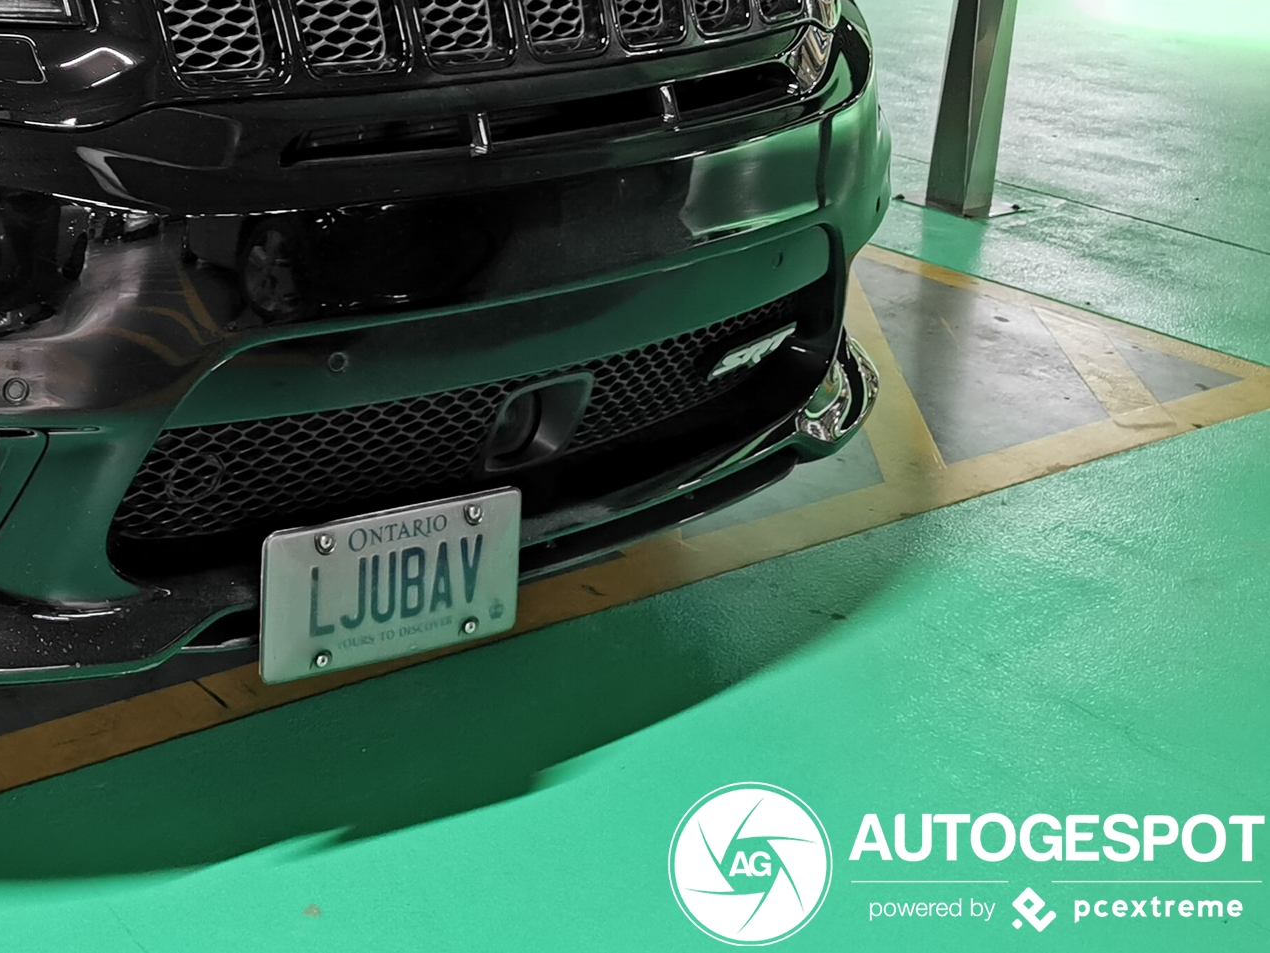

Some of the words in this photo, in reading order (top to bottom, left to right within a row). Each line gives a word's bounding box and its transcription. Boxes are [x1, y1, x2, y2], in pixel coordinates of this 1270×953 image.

[712, 327, 796, 377] SRT
[348, 514, 448, 553] ONTARIO
[310, 534, 483, 637] LJUBAV
[337, 635, 376, 651] YOURS
[380, 628, 396, 642] TO
[399, 615, 454, 638] DISCOVER
